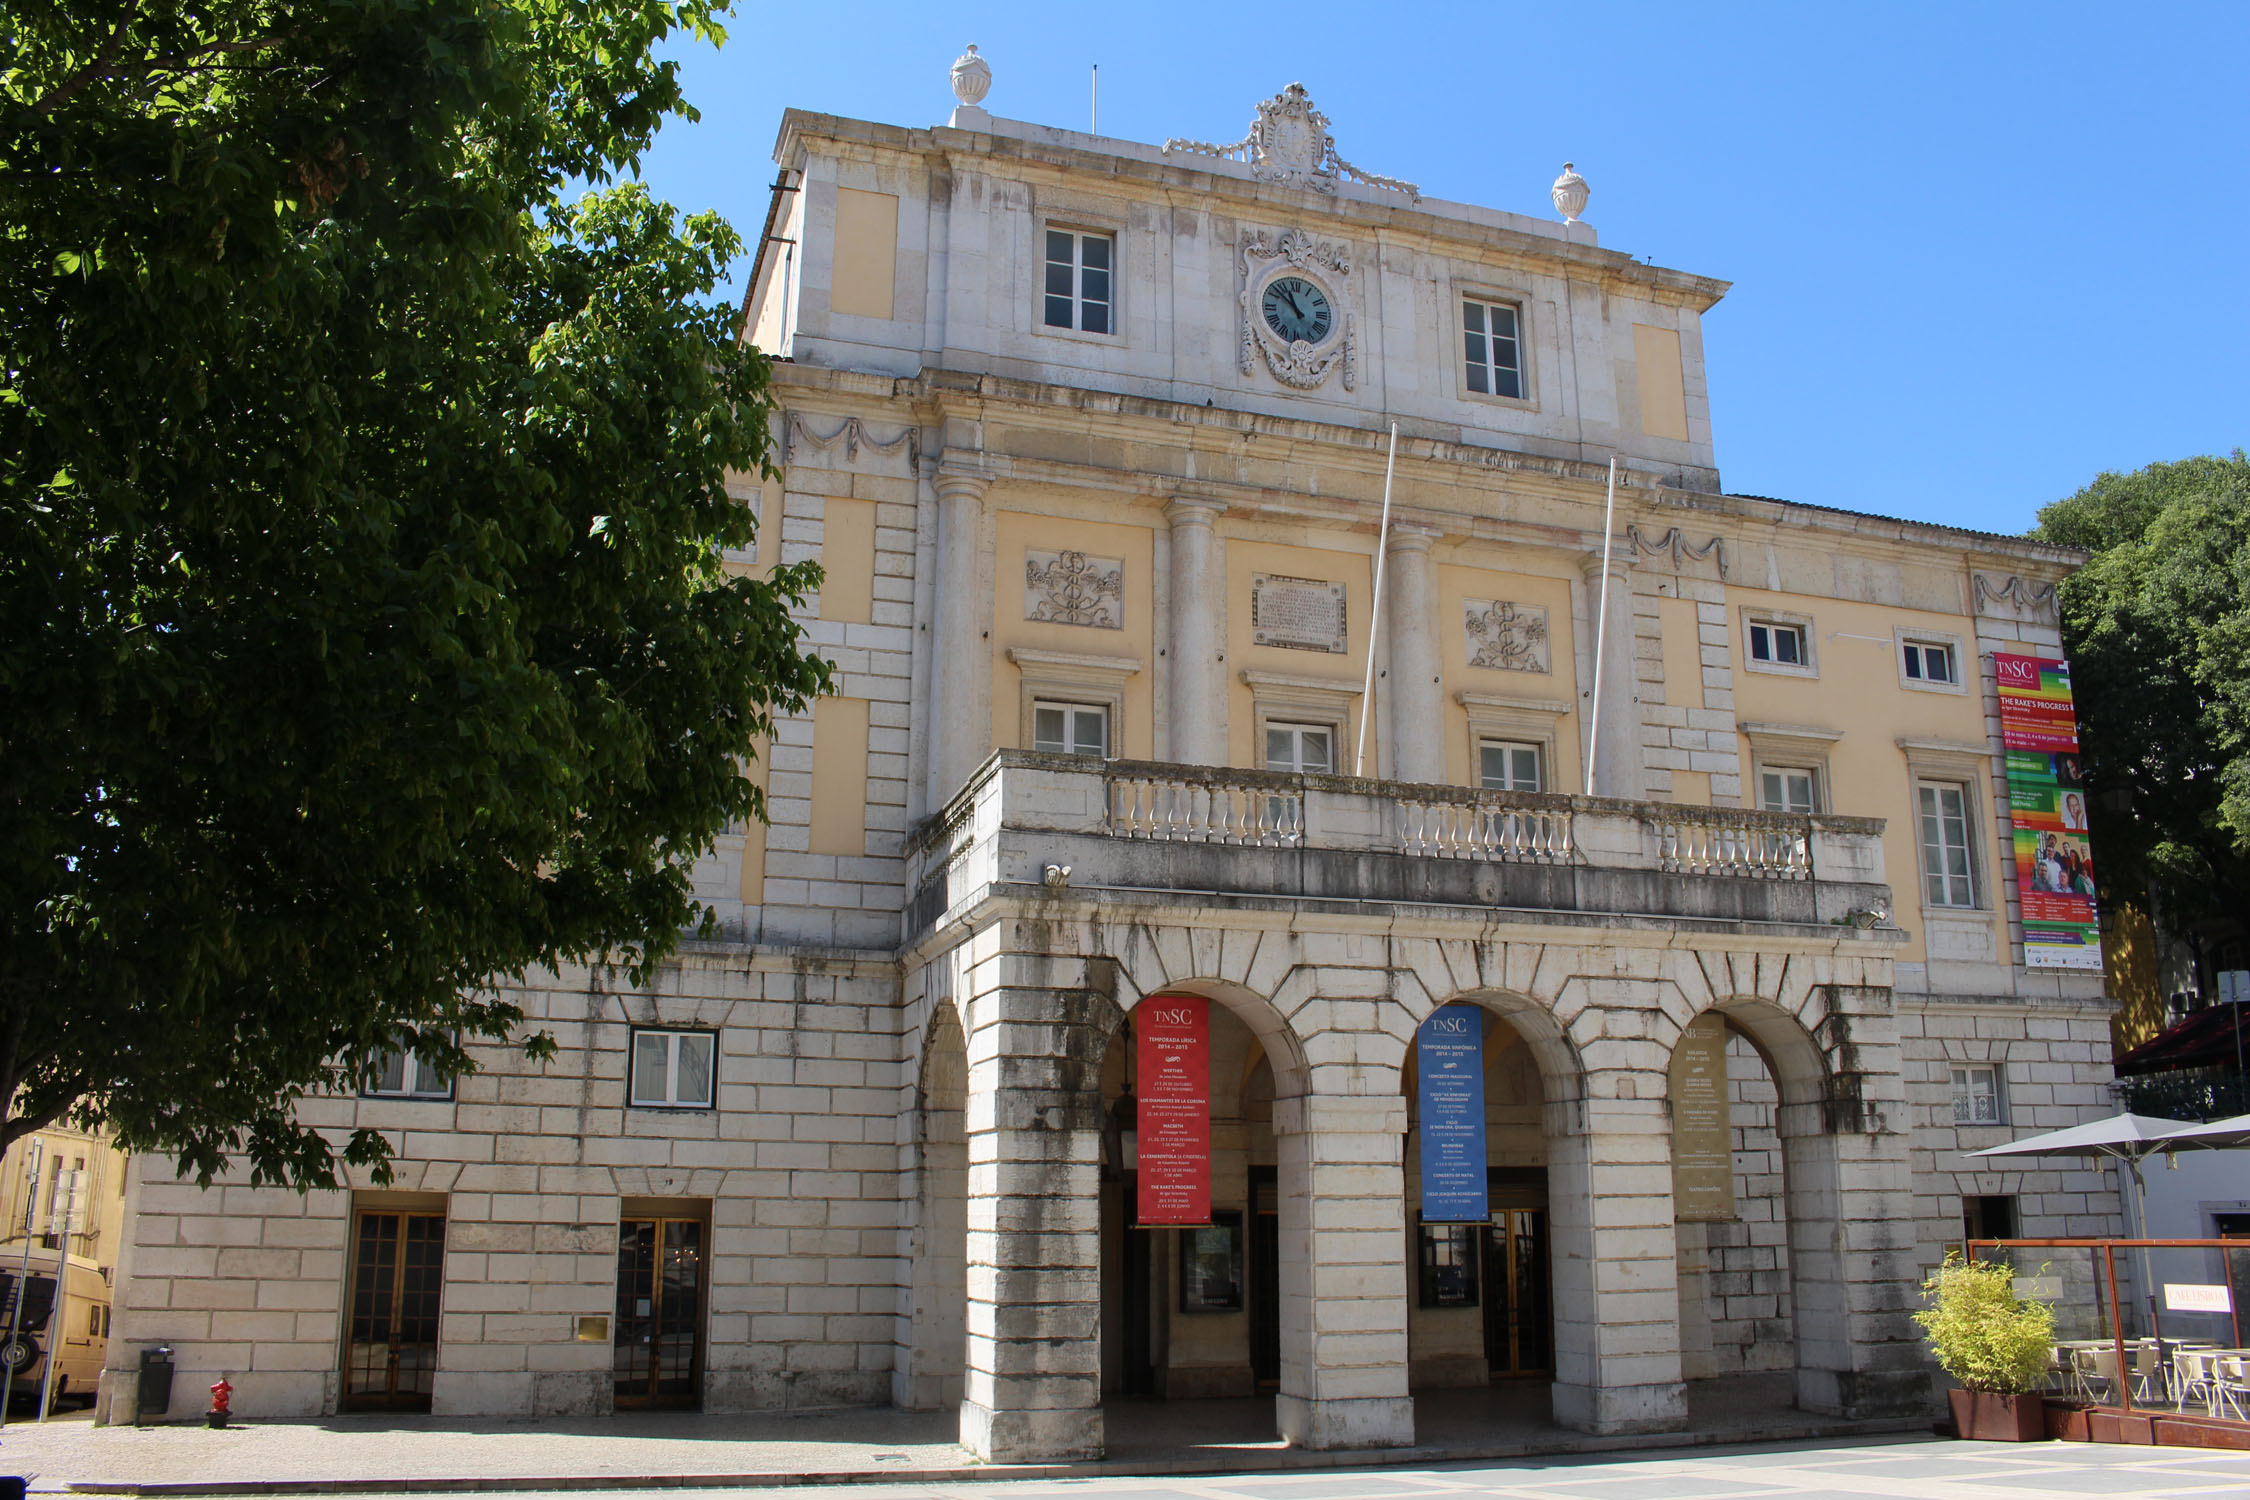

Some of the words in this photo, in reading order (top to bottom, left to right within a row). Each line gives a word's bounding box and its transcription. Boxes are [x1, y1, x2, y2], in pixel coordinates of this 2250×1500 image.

[1996, 660, 2034, 680] TNSC
[2000, 697, 2013, 705] THE
[2014, 699, 2036, 708] RAKE'S
[2037, 701, 2070, 711] PROGRESS
[1153, 1008, 1192, 1025] TNSC
[1432, 1017, 1467, 1033] TNSC
